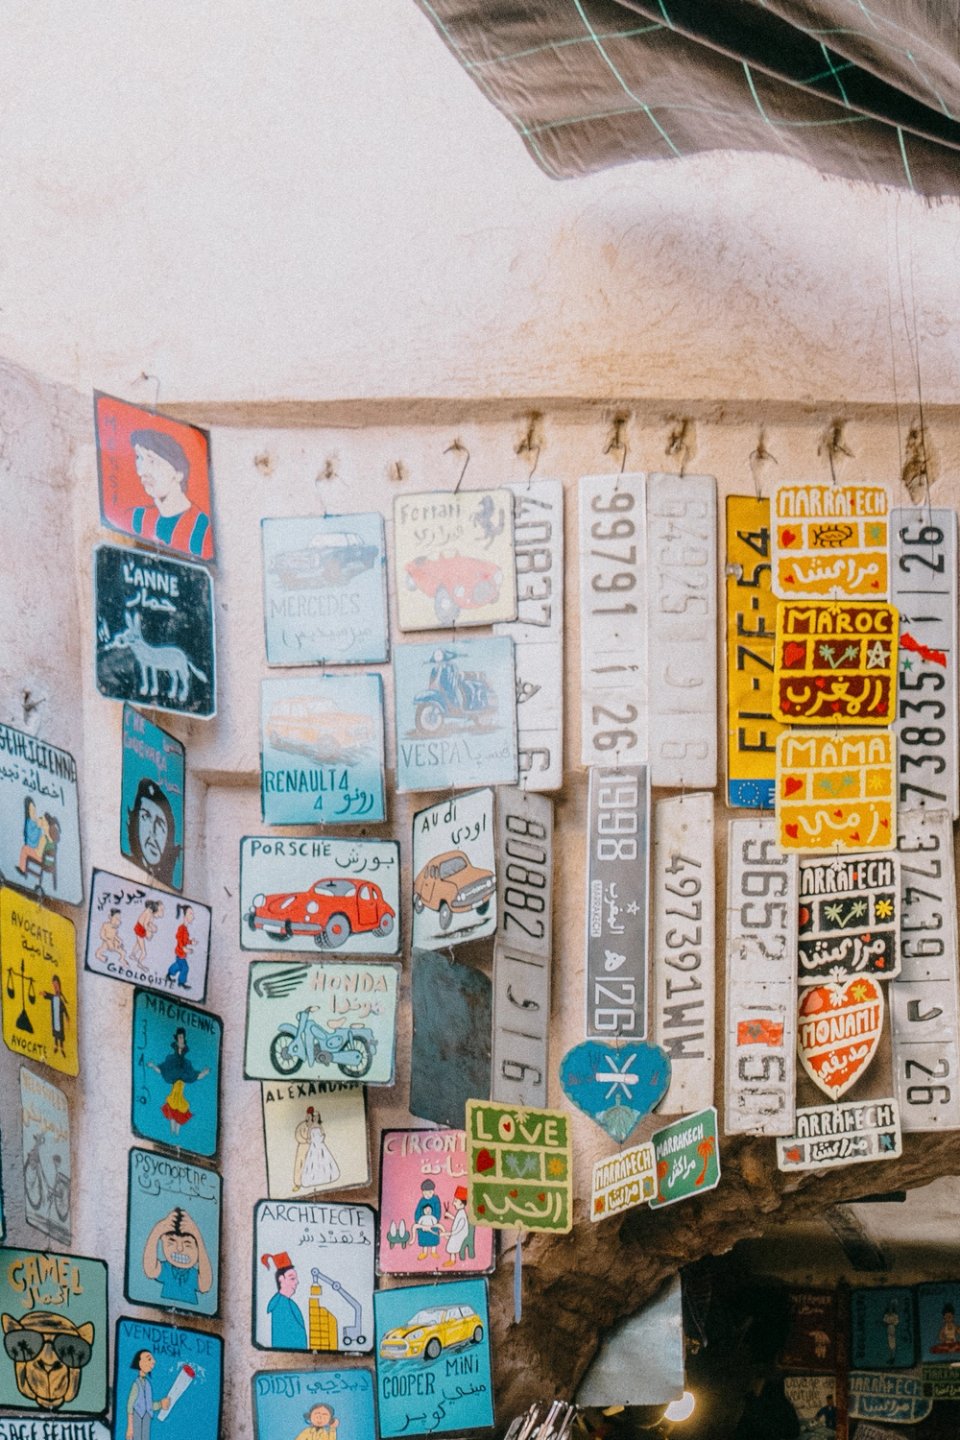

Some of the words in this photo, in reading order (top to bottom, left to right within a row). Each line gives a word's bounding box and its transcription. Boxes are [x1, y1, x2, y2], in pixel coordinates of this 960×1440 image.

[590, 492, 638, 615] 99791
[898, 524, 946, 575] 26
[269, 593, 362, 619] MERCEDES
[787, 608, 889, 635] MAROC
[785, 676, 884, 716] المغرب
[590, 702, 639, 752] 26
[898, 671, 948, 803] 73835
[400, 742, 462, 769] VESPA
[787, 740, 886, 768] MAMA
[597, 774, 638, 862] 1998
[502, 815, 547, 940] 80882
[800, 862, 891, 896] ARRAKECH
[10, 910, 55, 949] AVOCATE
[309, 972, 389, 994] HONDA
[11, 1034, 49, 1058] AVOCATE
[904, 1057, 952, 1106] 26
[476, 1110, 560, 1147] LOVE
[797, 1104, 891, 1137] ARRAKECH
[656, 1122, 705, 1161] MARRAKECH
[260, 1204, 367, 1229] ARCHITECTE
[482, 1189, 563, 1224] الحب
[7, 1255, 86, 1297] CAMEL
[123, 1322, 189, 1349] VENDEUR
[382, 1372, 437, 1400] COOPER
